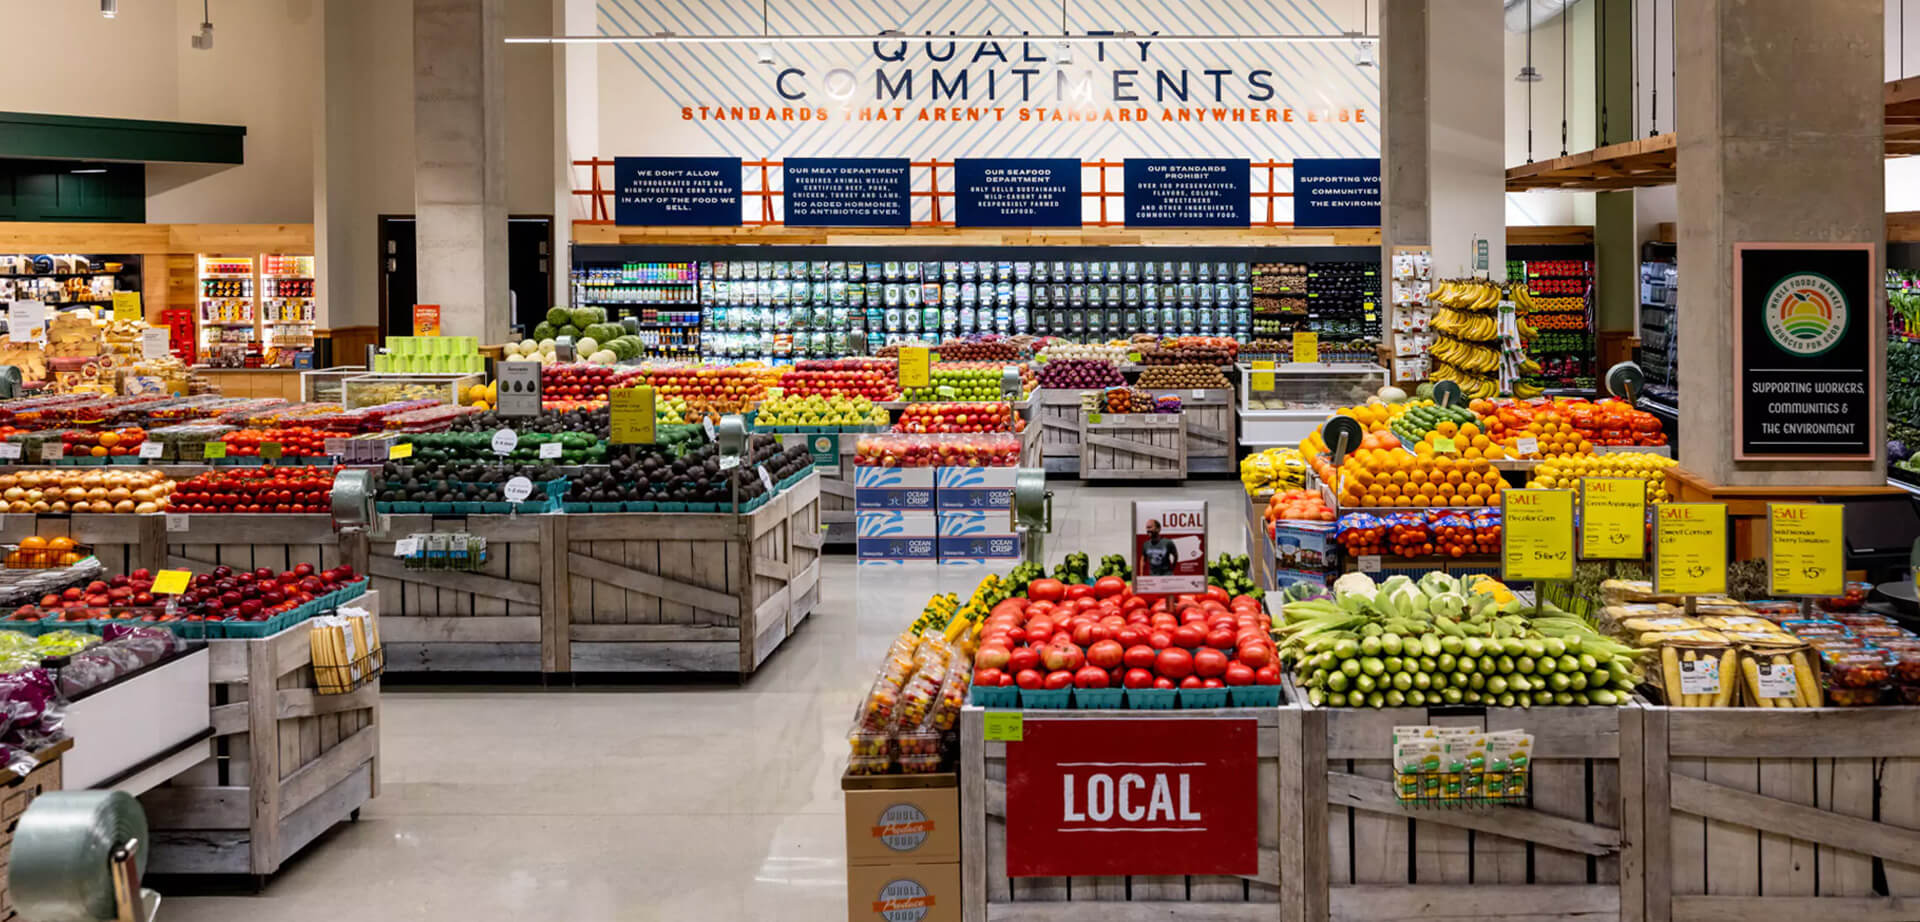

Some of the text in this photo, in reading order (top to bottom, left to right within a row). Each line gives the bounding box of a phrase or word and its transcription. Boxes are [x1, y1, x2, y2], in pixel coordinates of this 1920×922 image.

[873, 30, 1160, 62] QUALTY
[776, 68, 1275, 101] COMMITMENTS
[681, 107, 1366, 123] STANDARDS THAT AREN'T STANDARD ANYWHERE ESE
[1770, 279, 1842, 309] WHOLE FOODS MARKET
[1772, 324, 1841, 350] SOURCED FOR GOOD
[1752, 382, 1865, 393] SUPPORTING WORKERS,
[1768, 402, 1849, 414] COMMUNITIES &
[1762, 423, 1855, 435] THE ENVIRONMENT
[906, 496, 929, 505] CRISP
[1508, 494, 1542, 505] SALE
[1660, 508, 1693, 519] SALE
[1774, 508, 1808, 520] SALE
[1162, 512, 1203, 528] LOCAL
[990, 545, 1013, 553] CRISP
[1063, 772, 1201, 822] LOCAL
[887, 810, 921, 821] WHOLE
[882, 820, 924, 835] Produce
[889, 836, 921, 846] FOODS
[887, 886, 921, 896] WHOLE
[882, 896, 925, 911] Produce
[889, 910, 922, 921] FOODS
